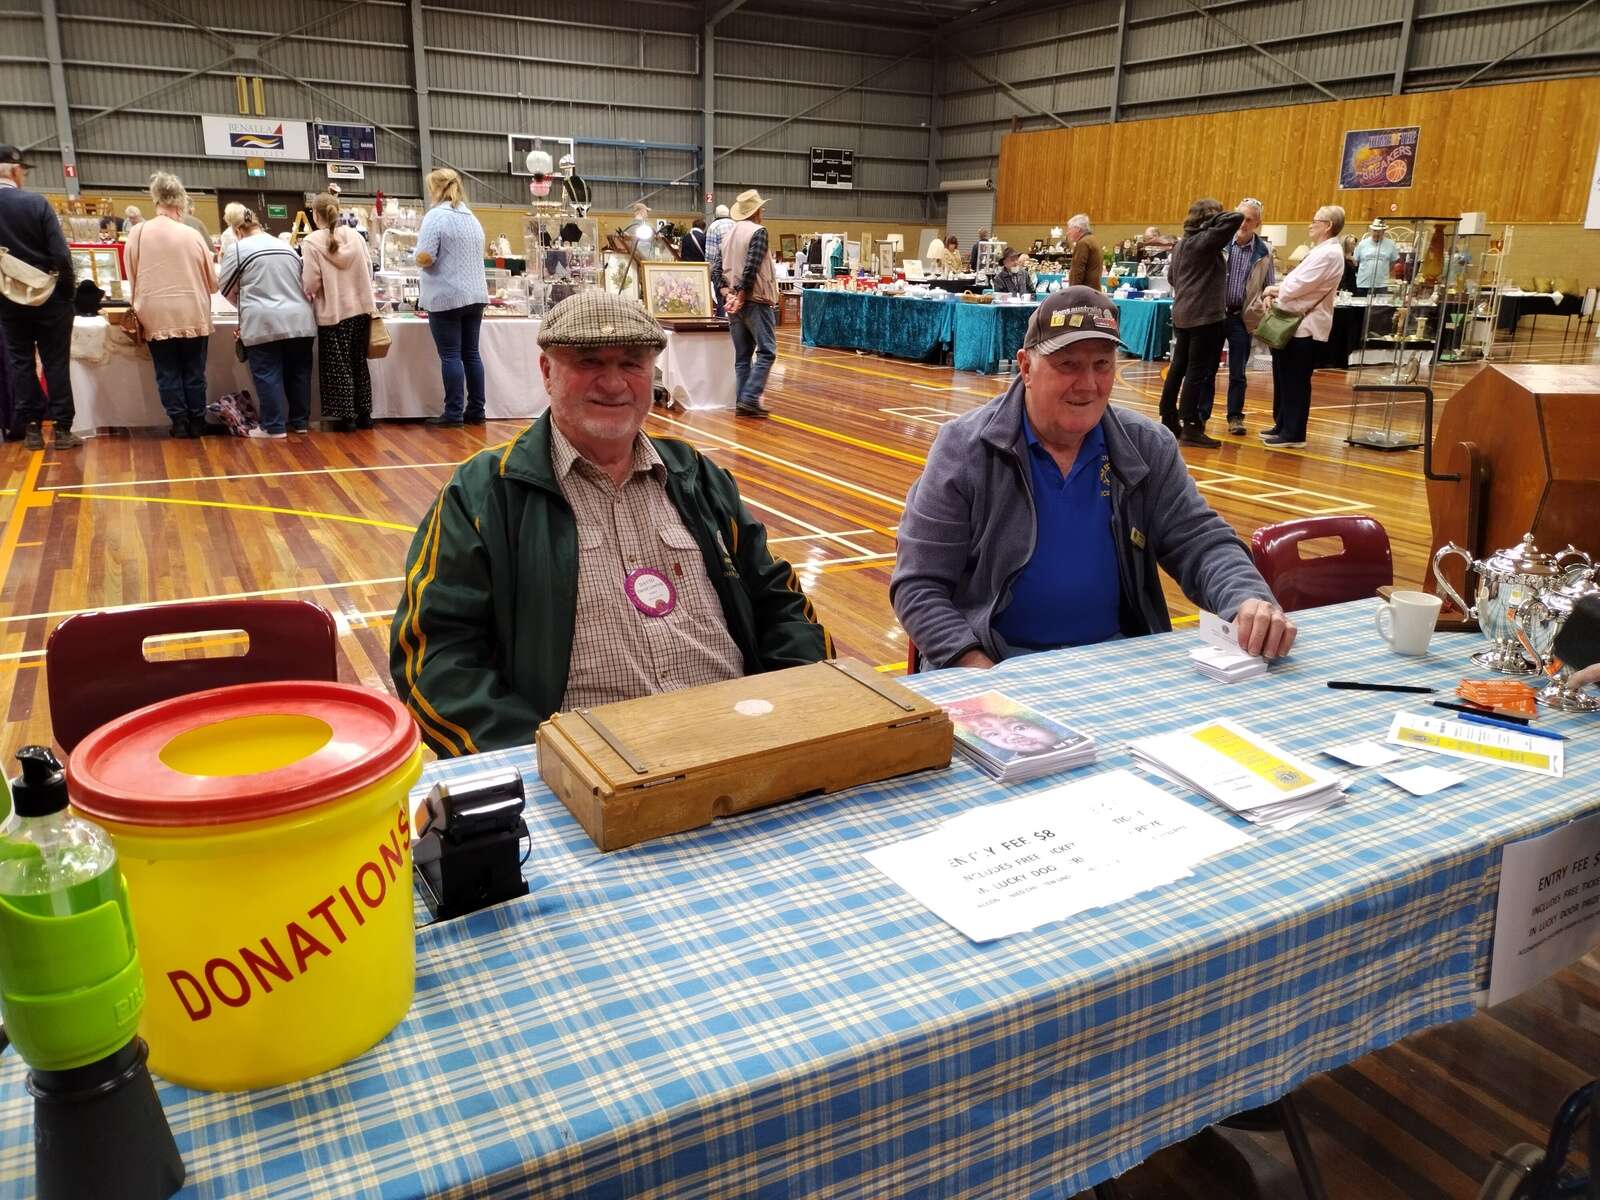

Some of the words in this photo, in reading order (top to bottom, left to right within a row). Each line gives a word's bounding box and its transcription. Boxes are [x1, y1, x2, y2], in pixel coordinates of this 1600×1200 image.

[228, 122, 273, 134] BENALLA
[1362, 146, 1412, 180] BREAKERS
[66, 166, 74, 177] 1
[706, 194, 713, 203] 2
[1033, 829, 1056, 841] $8
[992, 874, 1028, 890] LUCKY
[1538, 864, 1568, 891] ENTRY
[1572, 857, 1589, 874] FEE
[167, 807, 411, 1022] DONATIONS
[1528, 926, 1537, 937] IN
[1539, 914, 1557, 931] LUCKY
[1560, 903, 1580, 920] DOOR
